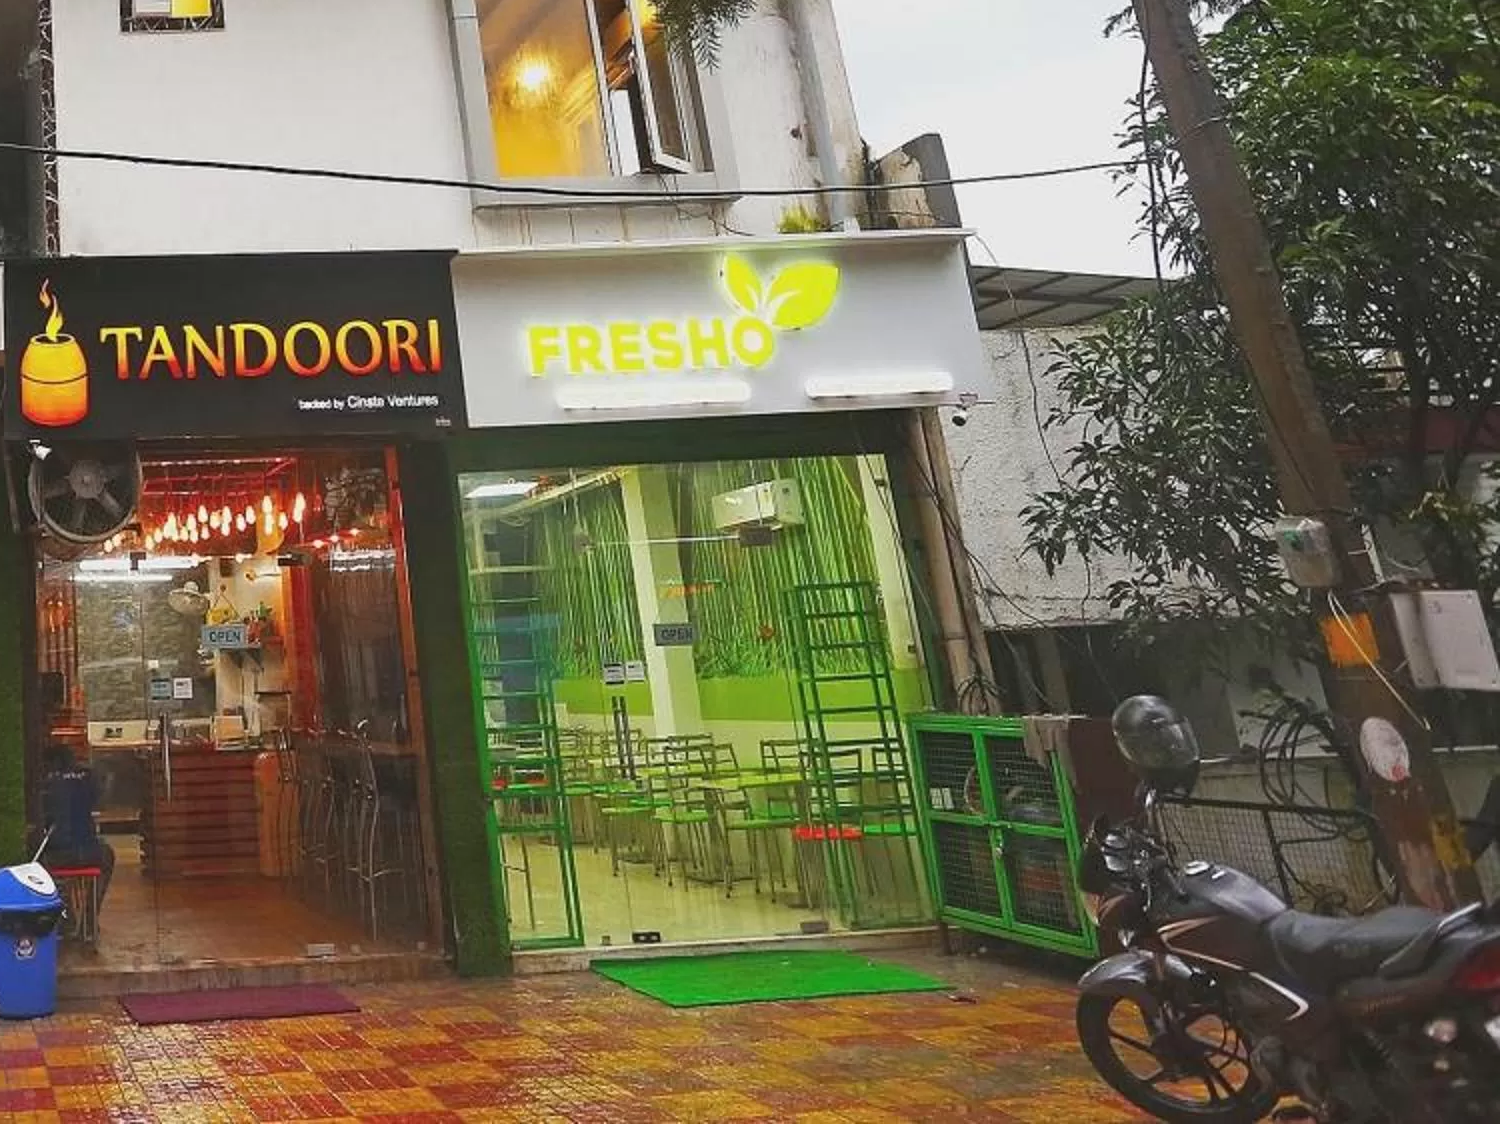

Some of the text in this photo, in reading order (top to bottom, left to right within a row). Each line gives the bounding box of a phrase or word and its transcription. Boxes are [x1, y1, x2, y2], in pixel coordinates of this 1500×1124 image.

[100, 318, 442, 380] TANDOORI
[528, 314, 775, 376] FRESHO
[333, 398, 345, 411] by
[209, 631, 241, 642] OPEN
[661, 627, 693, 641] OPEN
